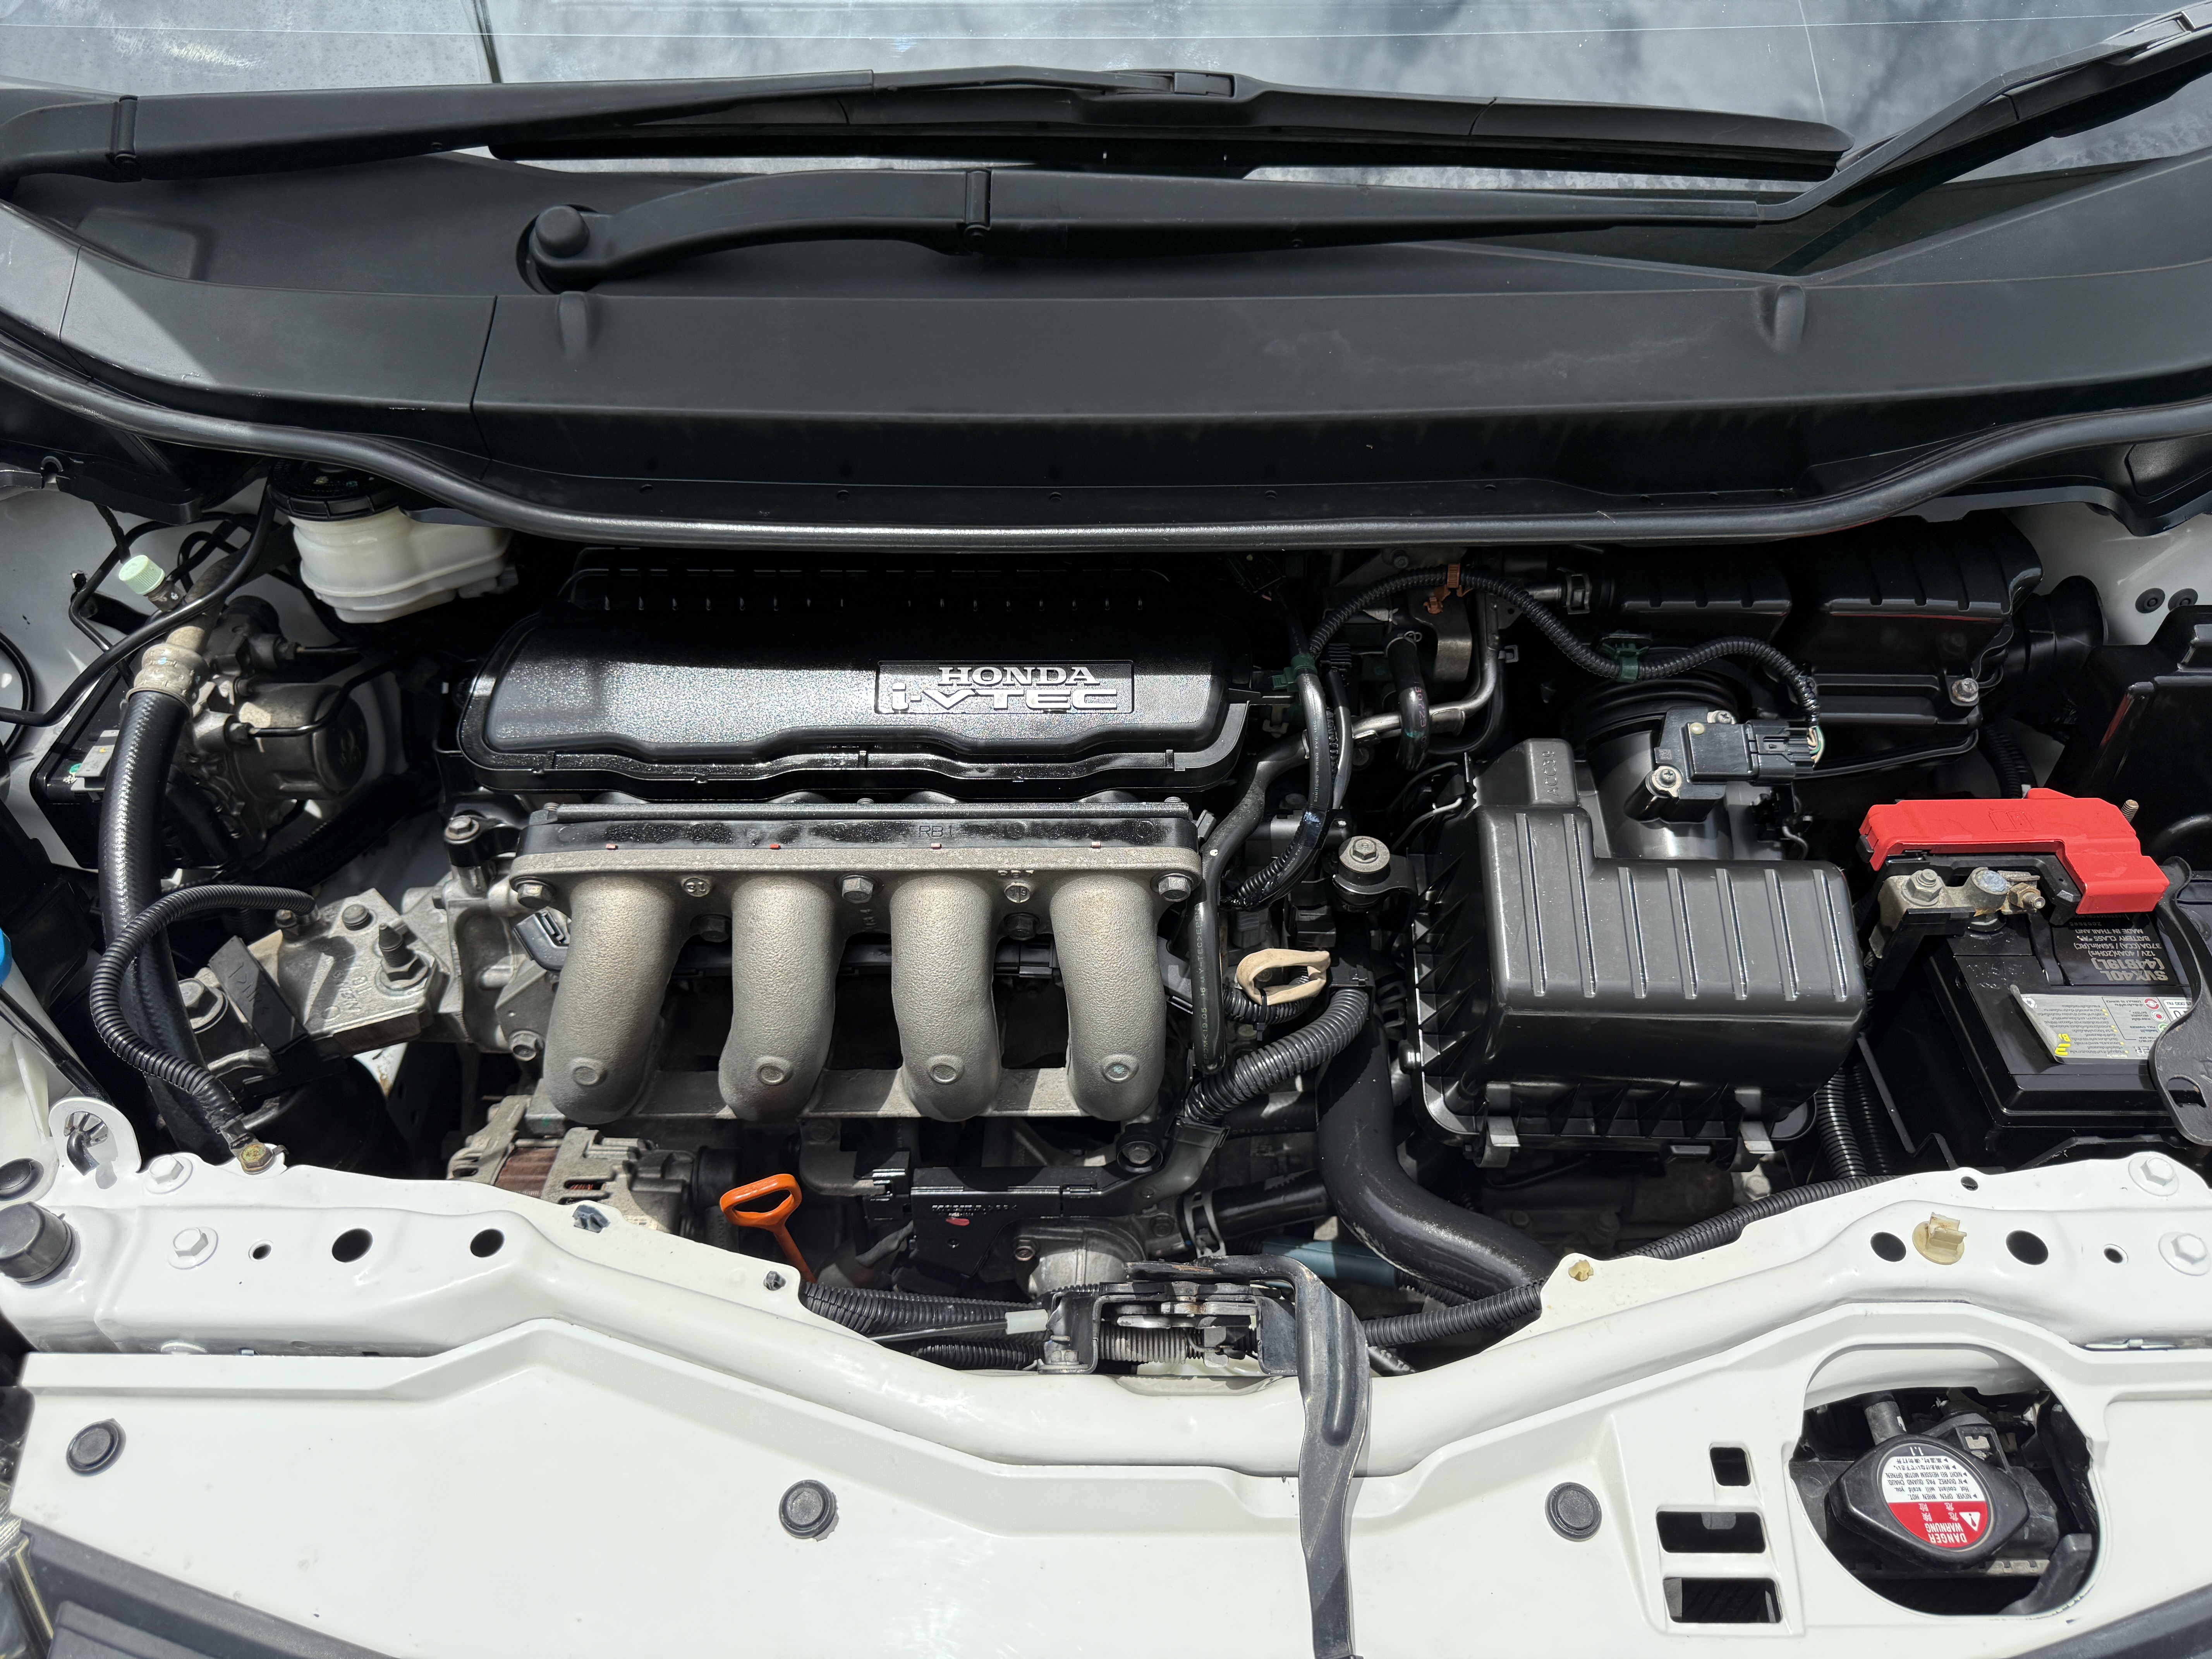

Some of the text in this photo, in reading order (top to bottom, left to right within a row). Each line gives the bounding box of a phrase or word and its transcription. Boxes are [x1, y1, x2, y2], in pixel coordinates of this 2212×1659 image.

[938, 667, 1101, 685] HONDA
[891, 682, 1118, 710] i-VTEC
[2100, 970, 2169, 981] SVX40L
[1910, 1447, 1924, 1456] 1.1
[1924, 1522, 1964, 1533] WARNUNG
[1928, 1533, 1968, 1544] DANGER
